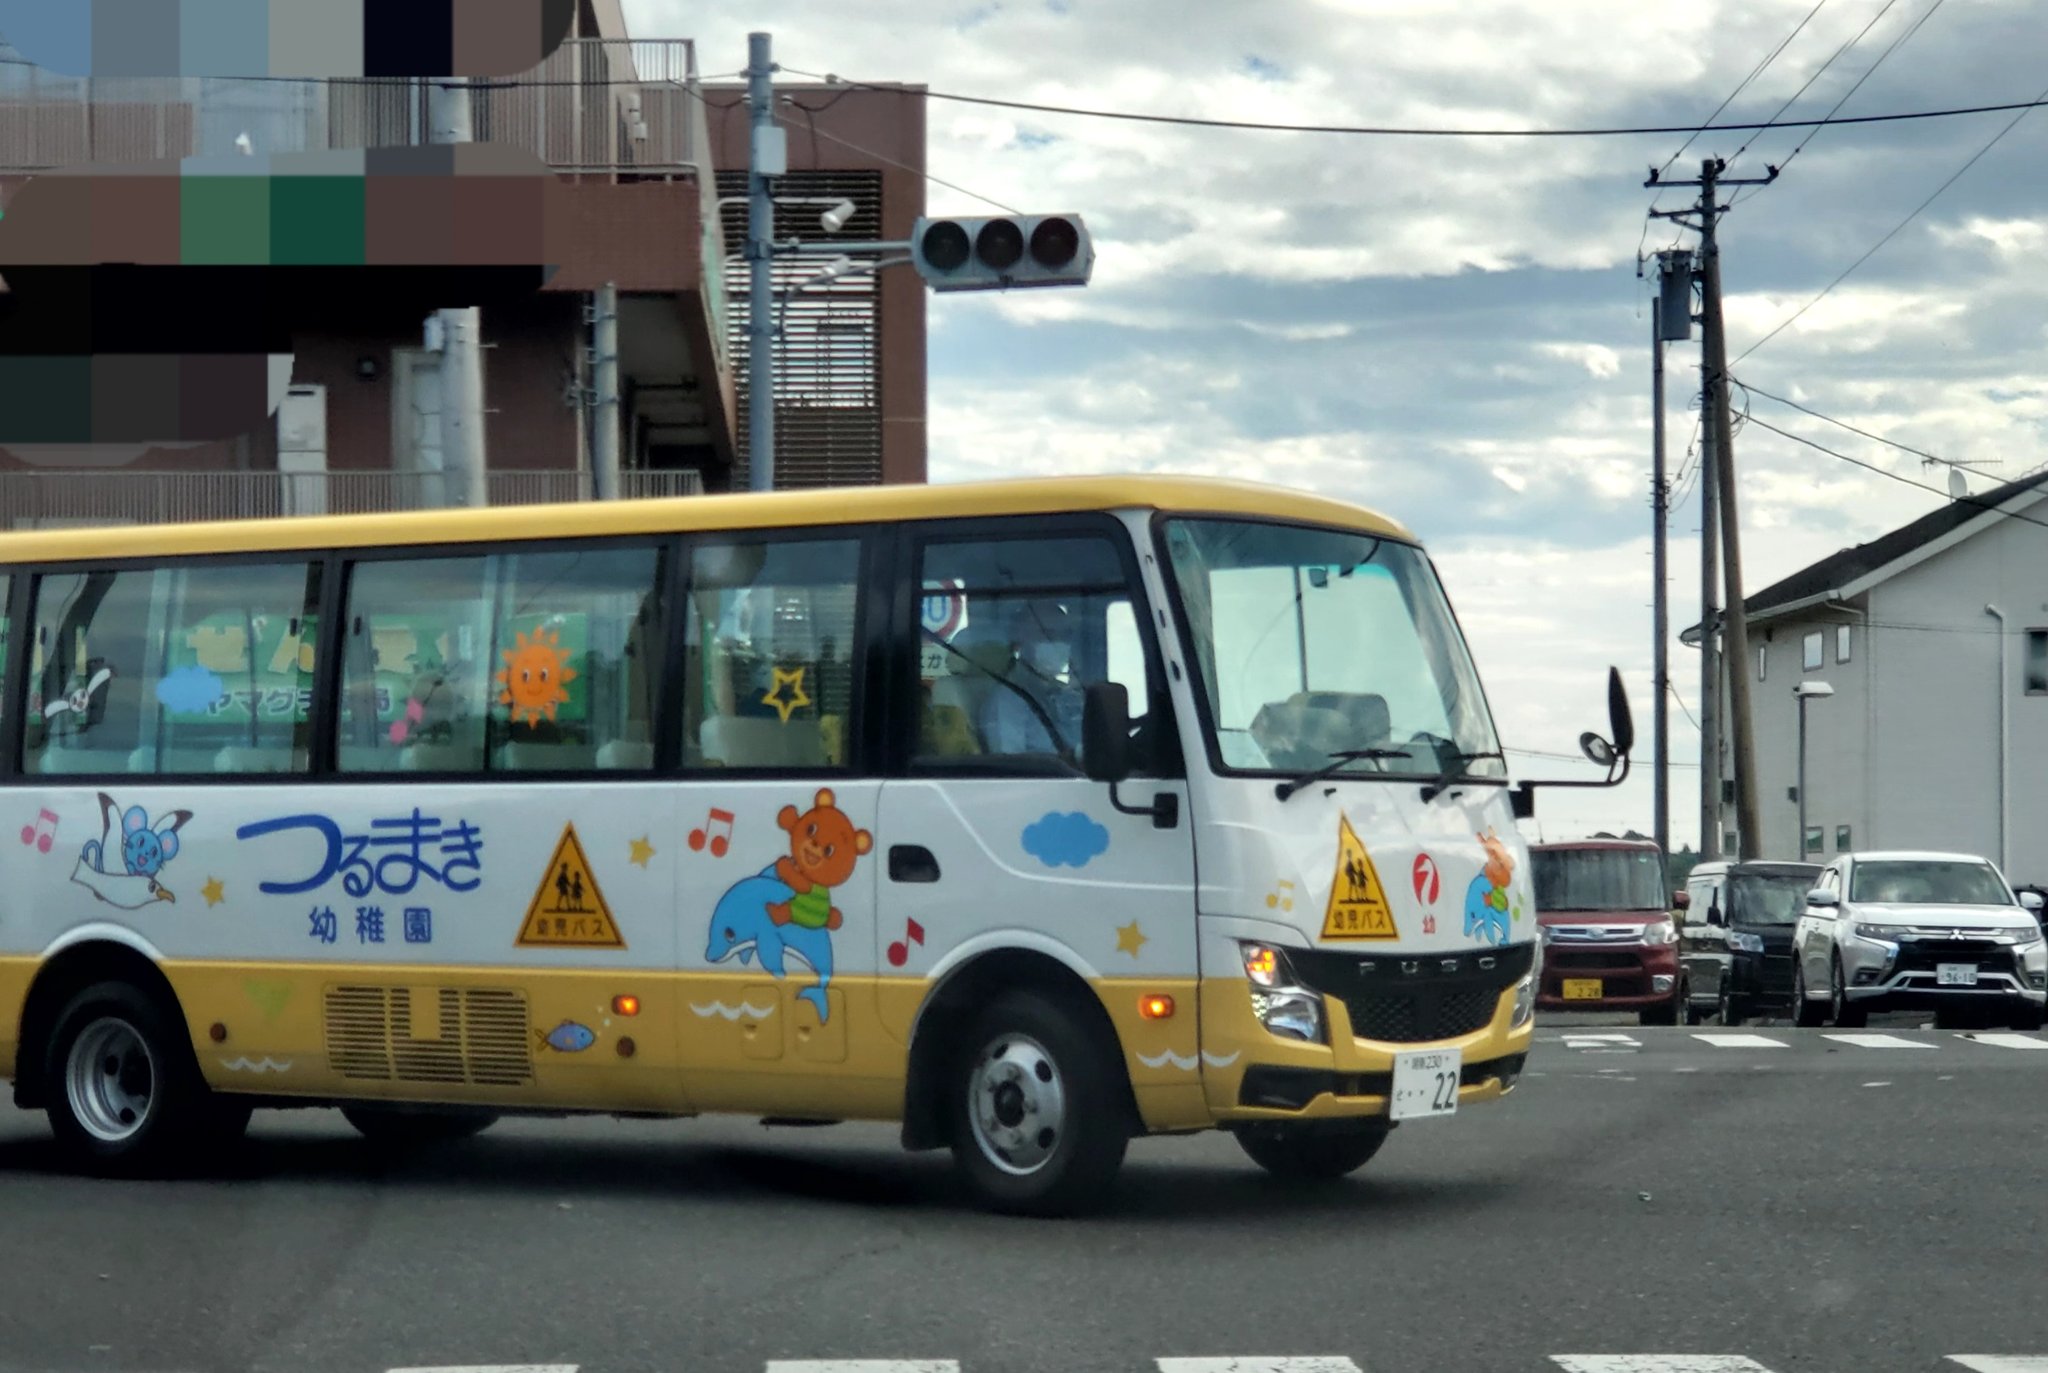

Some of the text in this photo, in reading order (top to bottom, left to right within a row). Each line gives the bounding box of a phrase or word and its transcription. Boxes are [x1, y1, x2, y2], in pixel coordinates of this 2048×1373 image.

[236, 807, 484, 898] つるまき
[309, 906, 431, 944] 幼稚園
[1359, 957, 1496, 976] FUSO
[1432, 1071, 1456, 1110] 22
